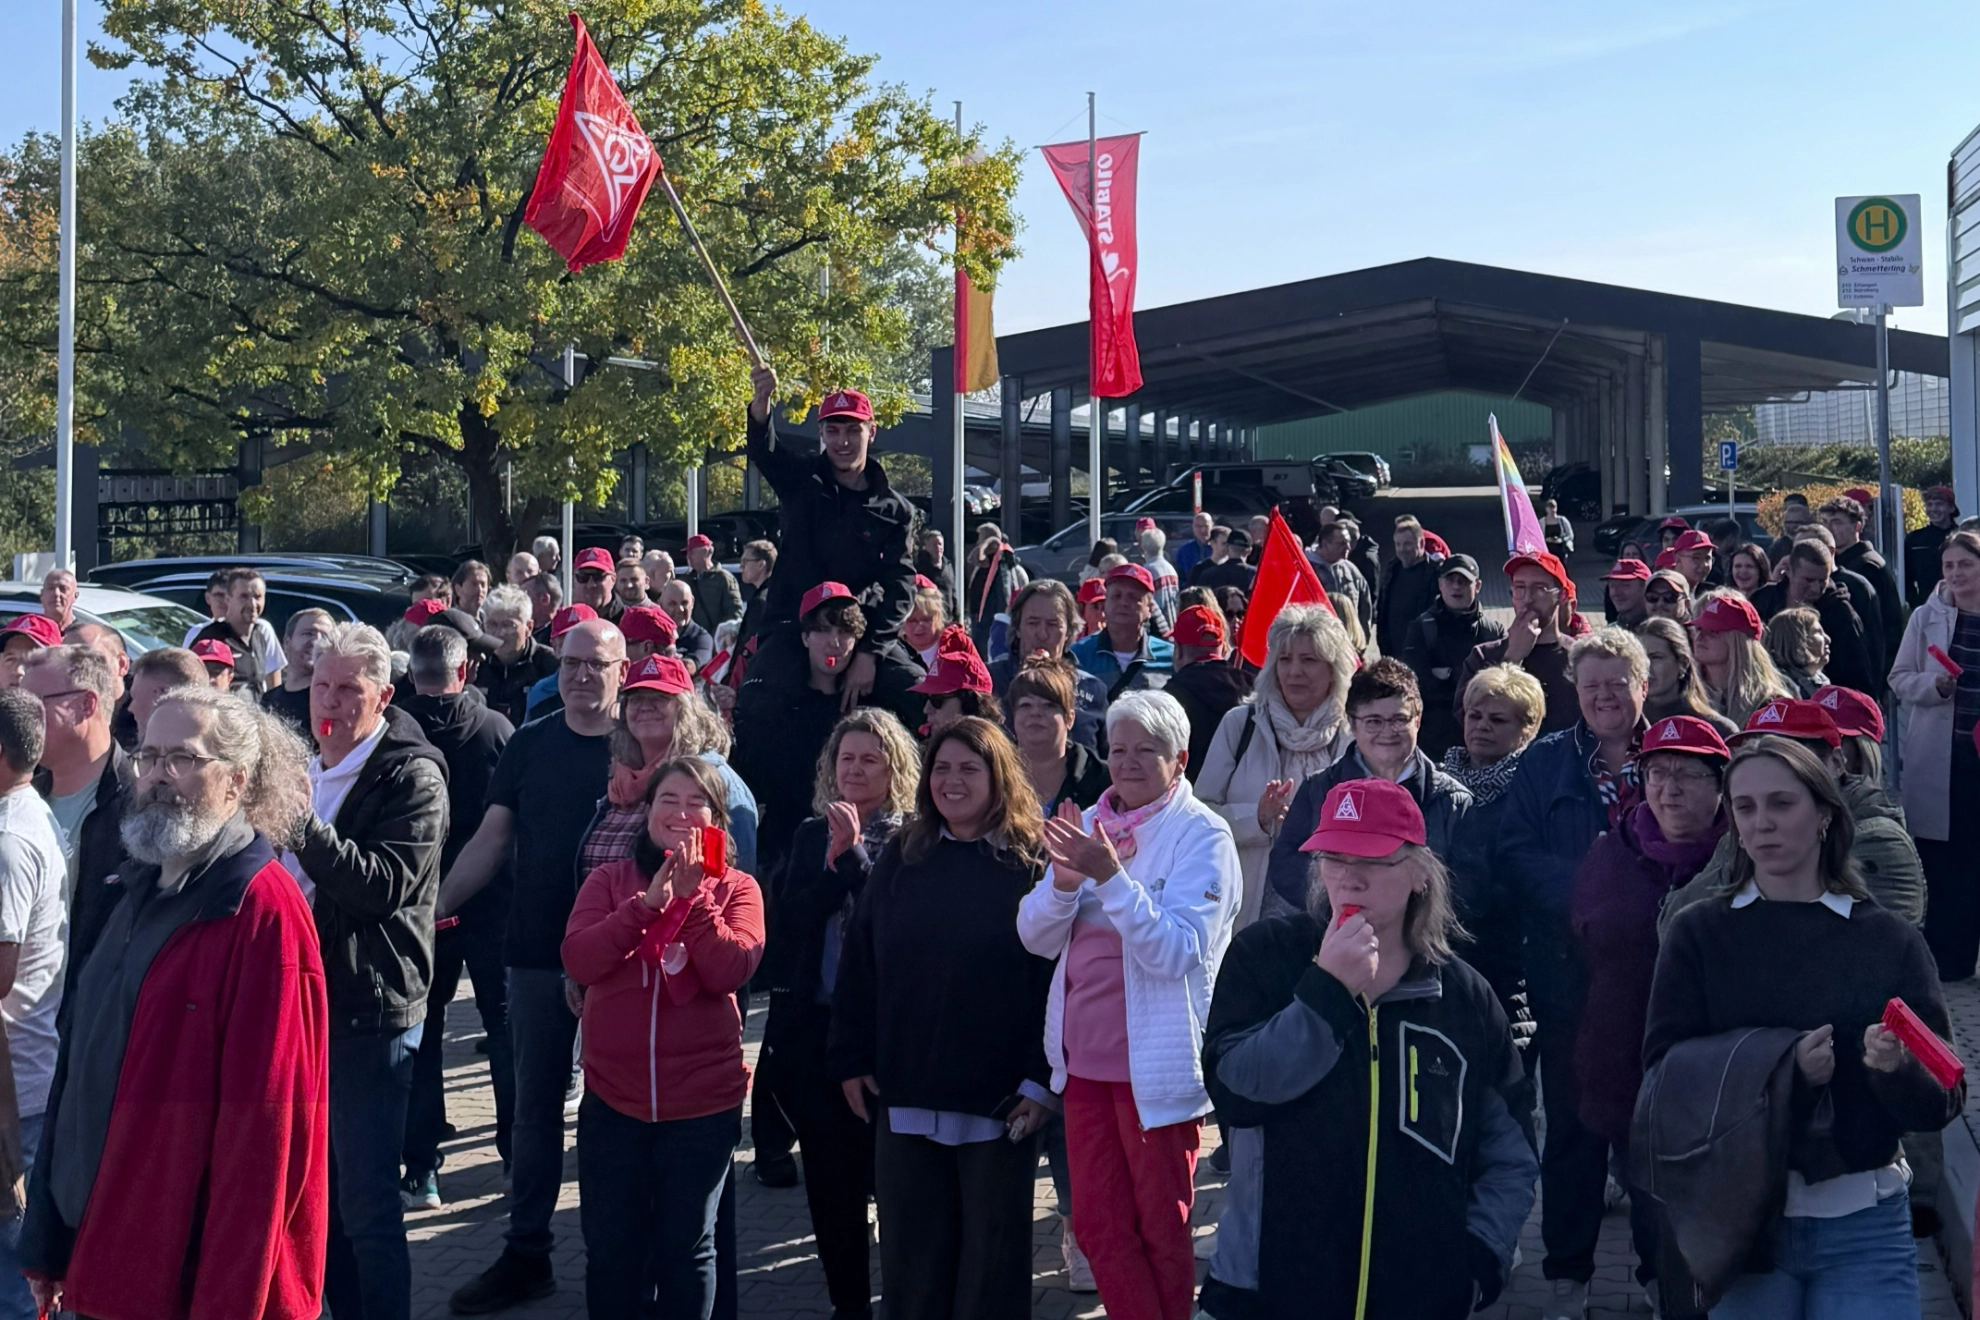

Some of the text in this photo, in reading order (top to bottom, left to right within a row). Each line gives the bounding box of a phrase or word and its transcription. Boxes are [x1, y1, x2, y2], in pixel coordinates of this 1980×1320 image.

[1865, 210, 1889, 240] H
[1880, 255, 1904, 263] Stabilo
[1851, 265, 1906, 273] Schmetterling
[1722, 444, 1732, 467] P
